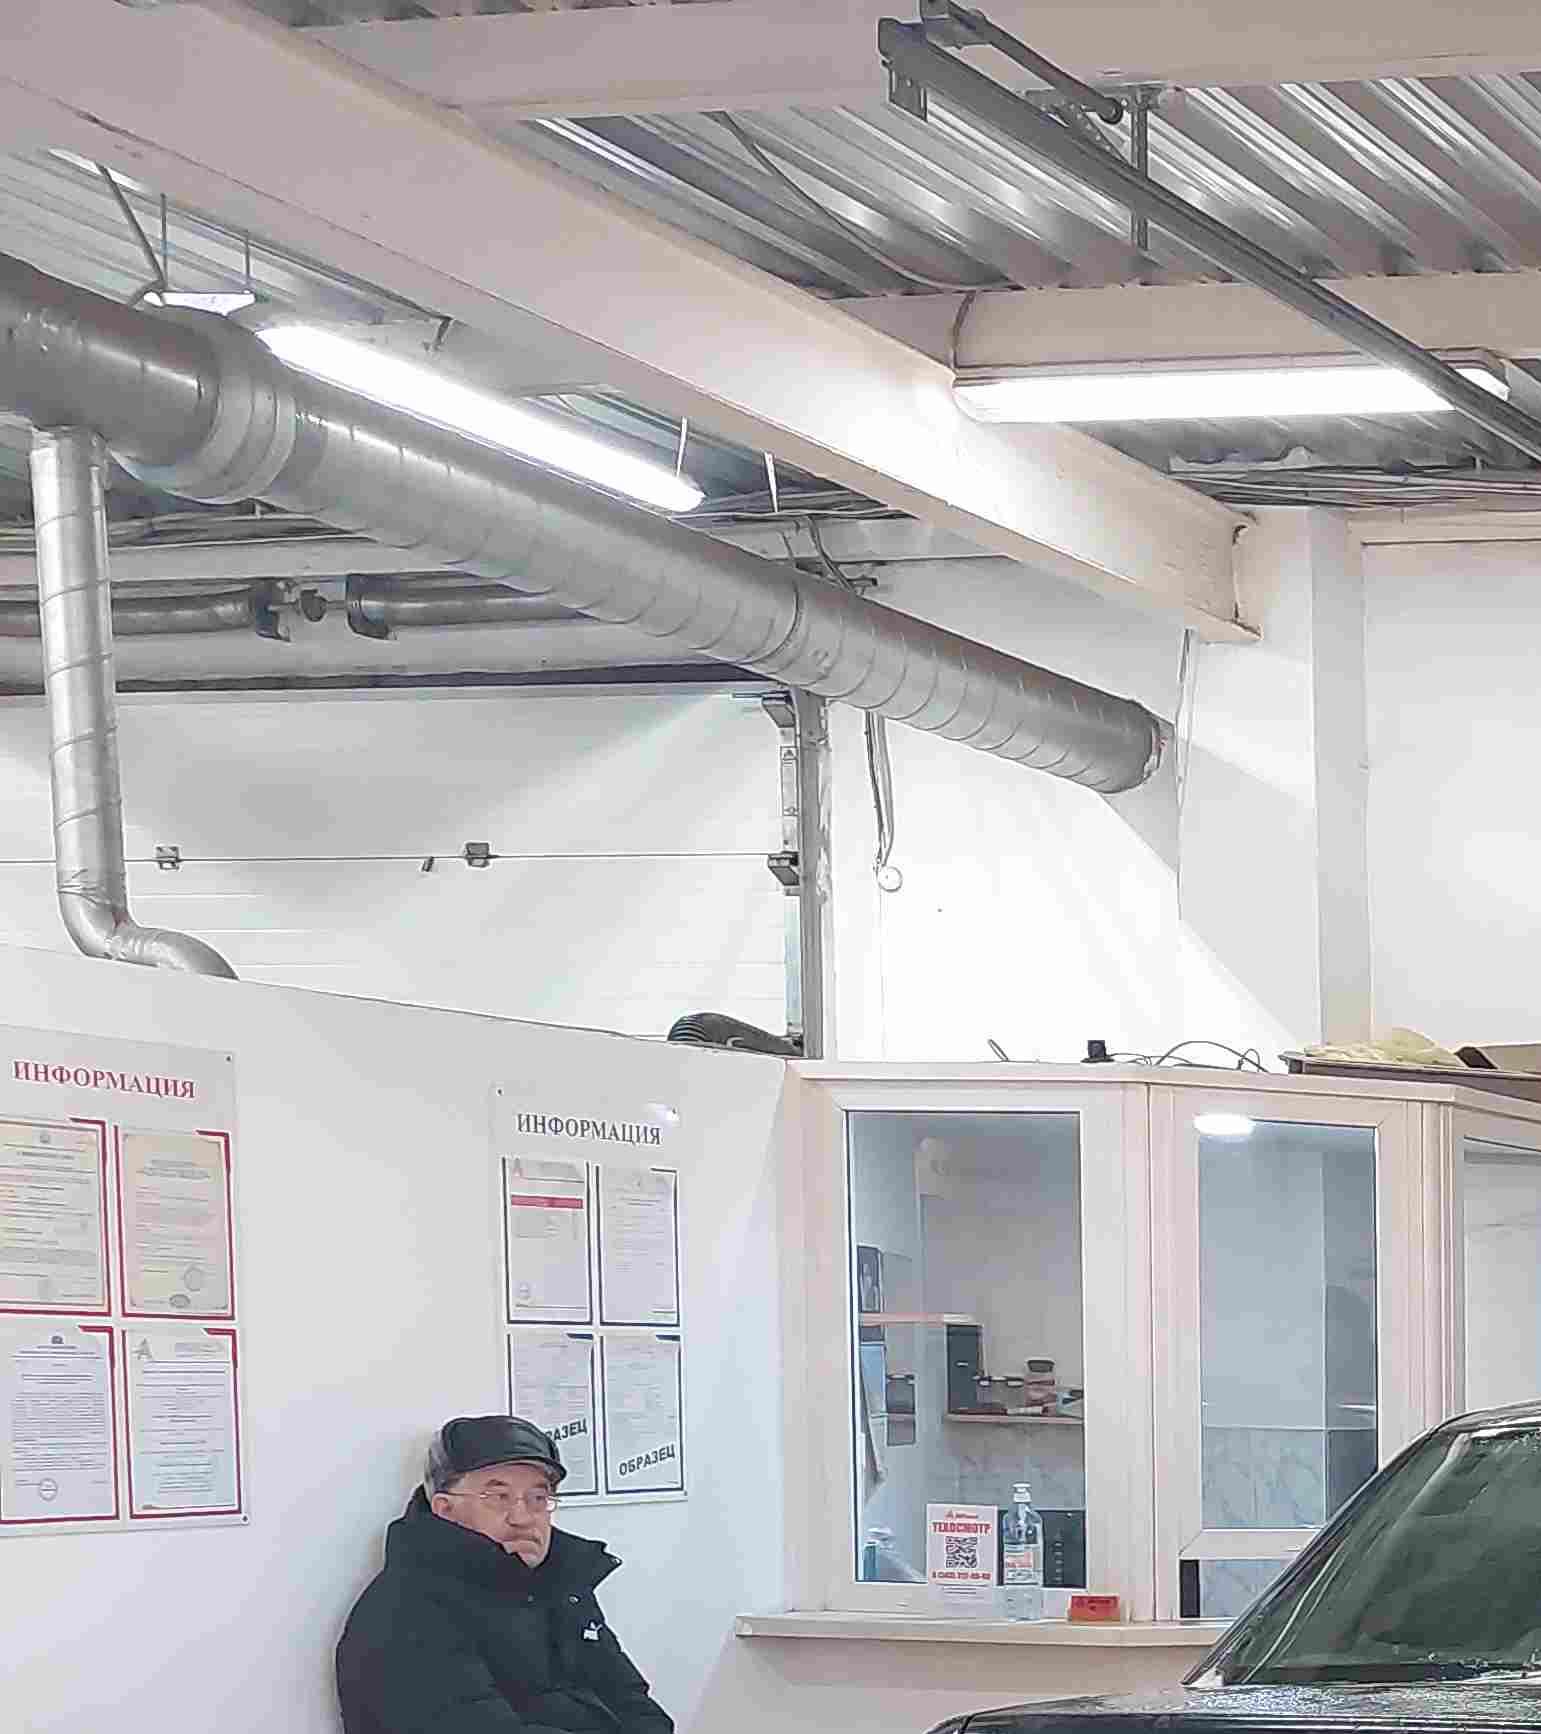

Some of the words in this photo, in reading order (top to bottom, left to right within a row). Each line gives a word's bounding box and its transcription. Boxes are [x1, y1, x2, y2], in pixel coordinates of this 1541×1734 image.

[14, 1060, 196, 1098] ИНФОРМАЦИЯ
[517, 1113, 661, 1146] ИНФОРМАЦИЯ
[545, 1418, 588, 1441] АЗЕЦ
[619, 1445, 675, 1476] ОБРАЗЕЦ
